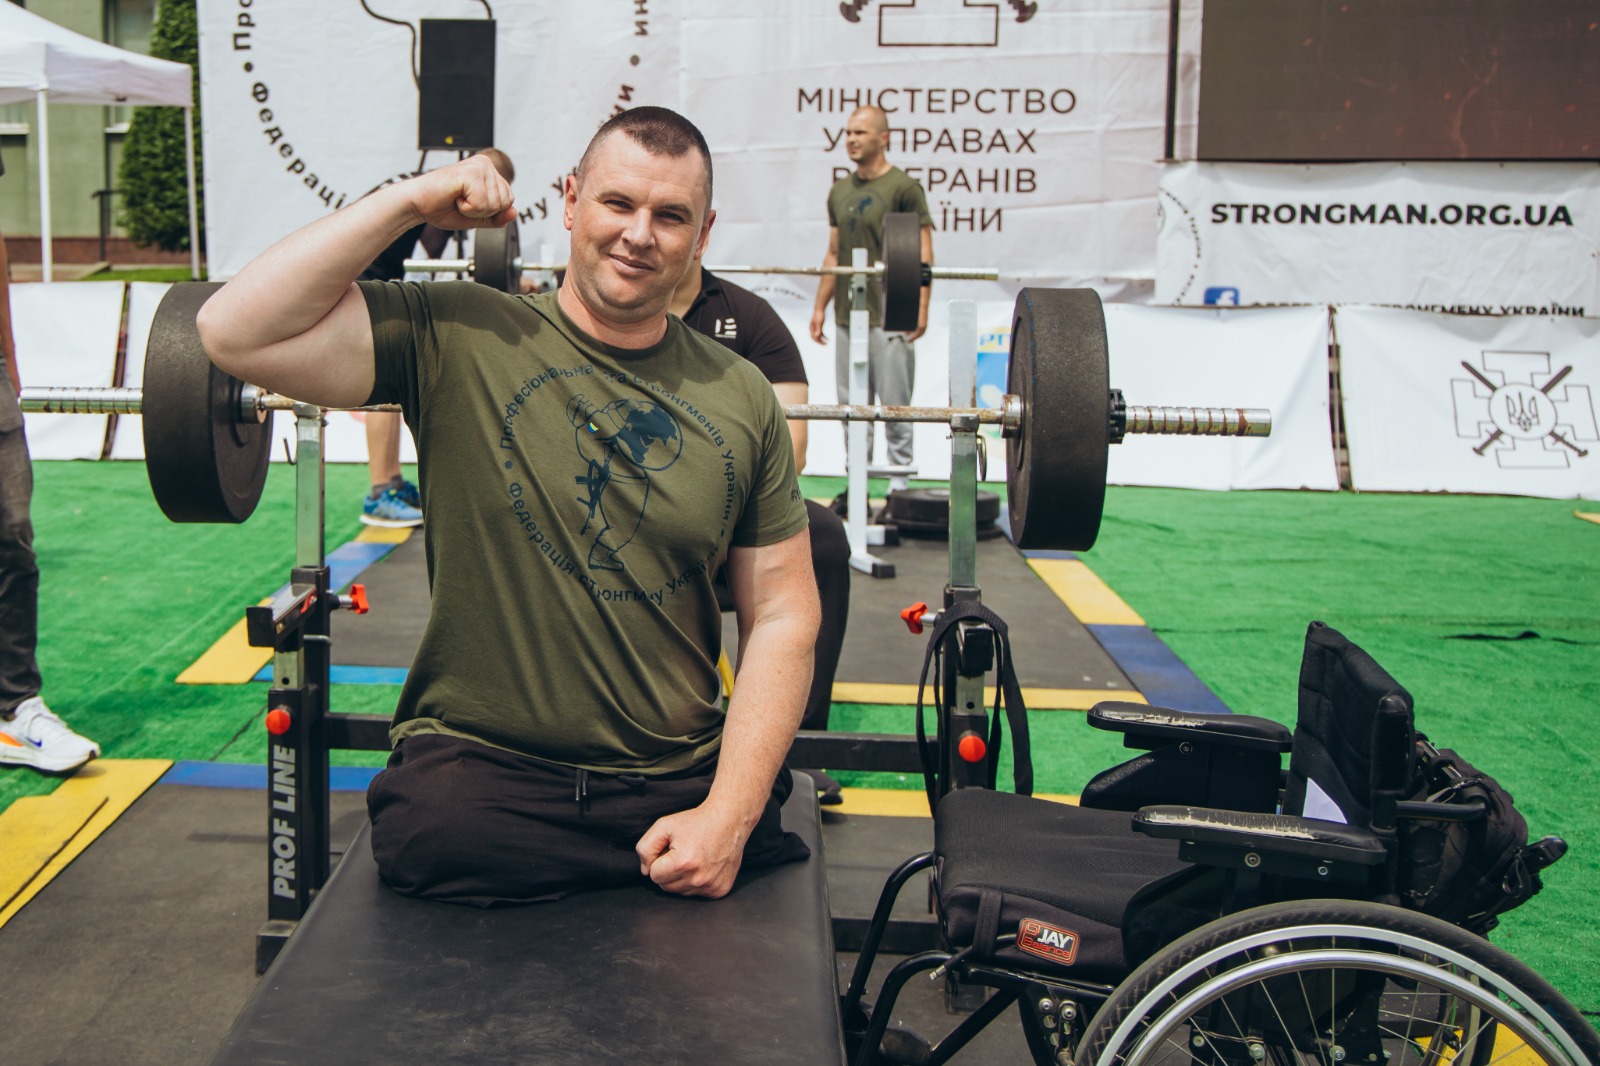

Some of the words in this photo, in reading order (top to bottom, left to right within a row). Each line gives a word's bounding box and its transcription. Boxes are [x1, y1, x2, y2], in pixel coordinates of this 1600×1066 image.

[797, 88, 1077, 114] МІНІСТЕРСТВО
[885, 127, 1038, 153] ПРАВАХ
[1210, 203, 1573, 227] STRONGMAN.ORG.UA
[500, 363, 595, 450] Професіонаьна
[508, 481, 576, 577] Федерація
[273, 744, 296, 813] LINE
[273, 818, 296, 900] PROF
[1037, 928, 1072, 949] JAY
